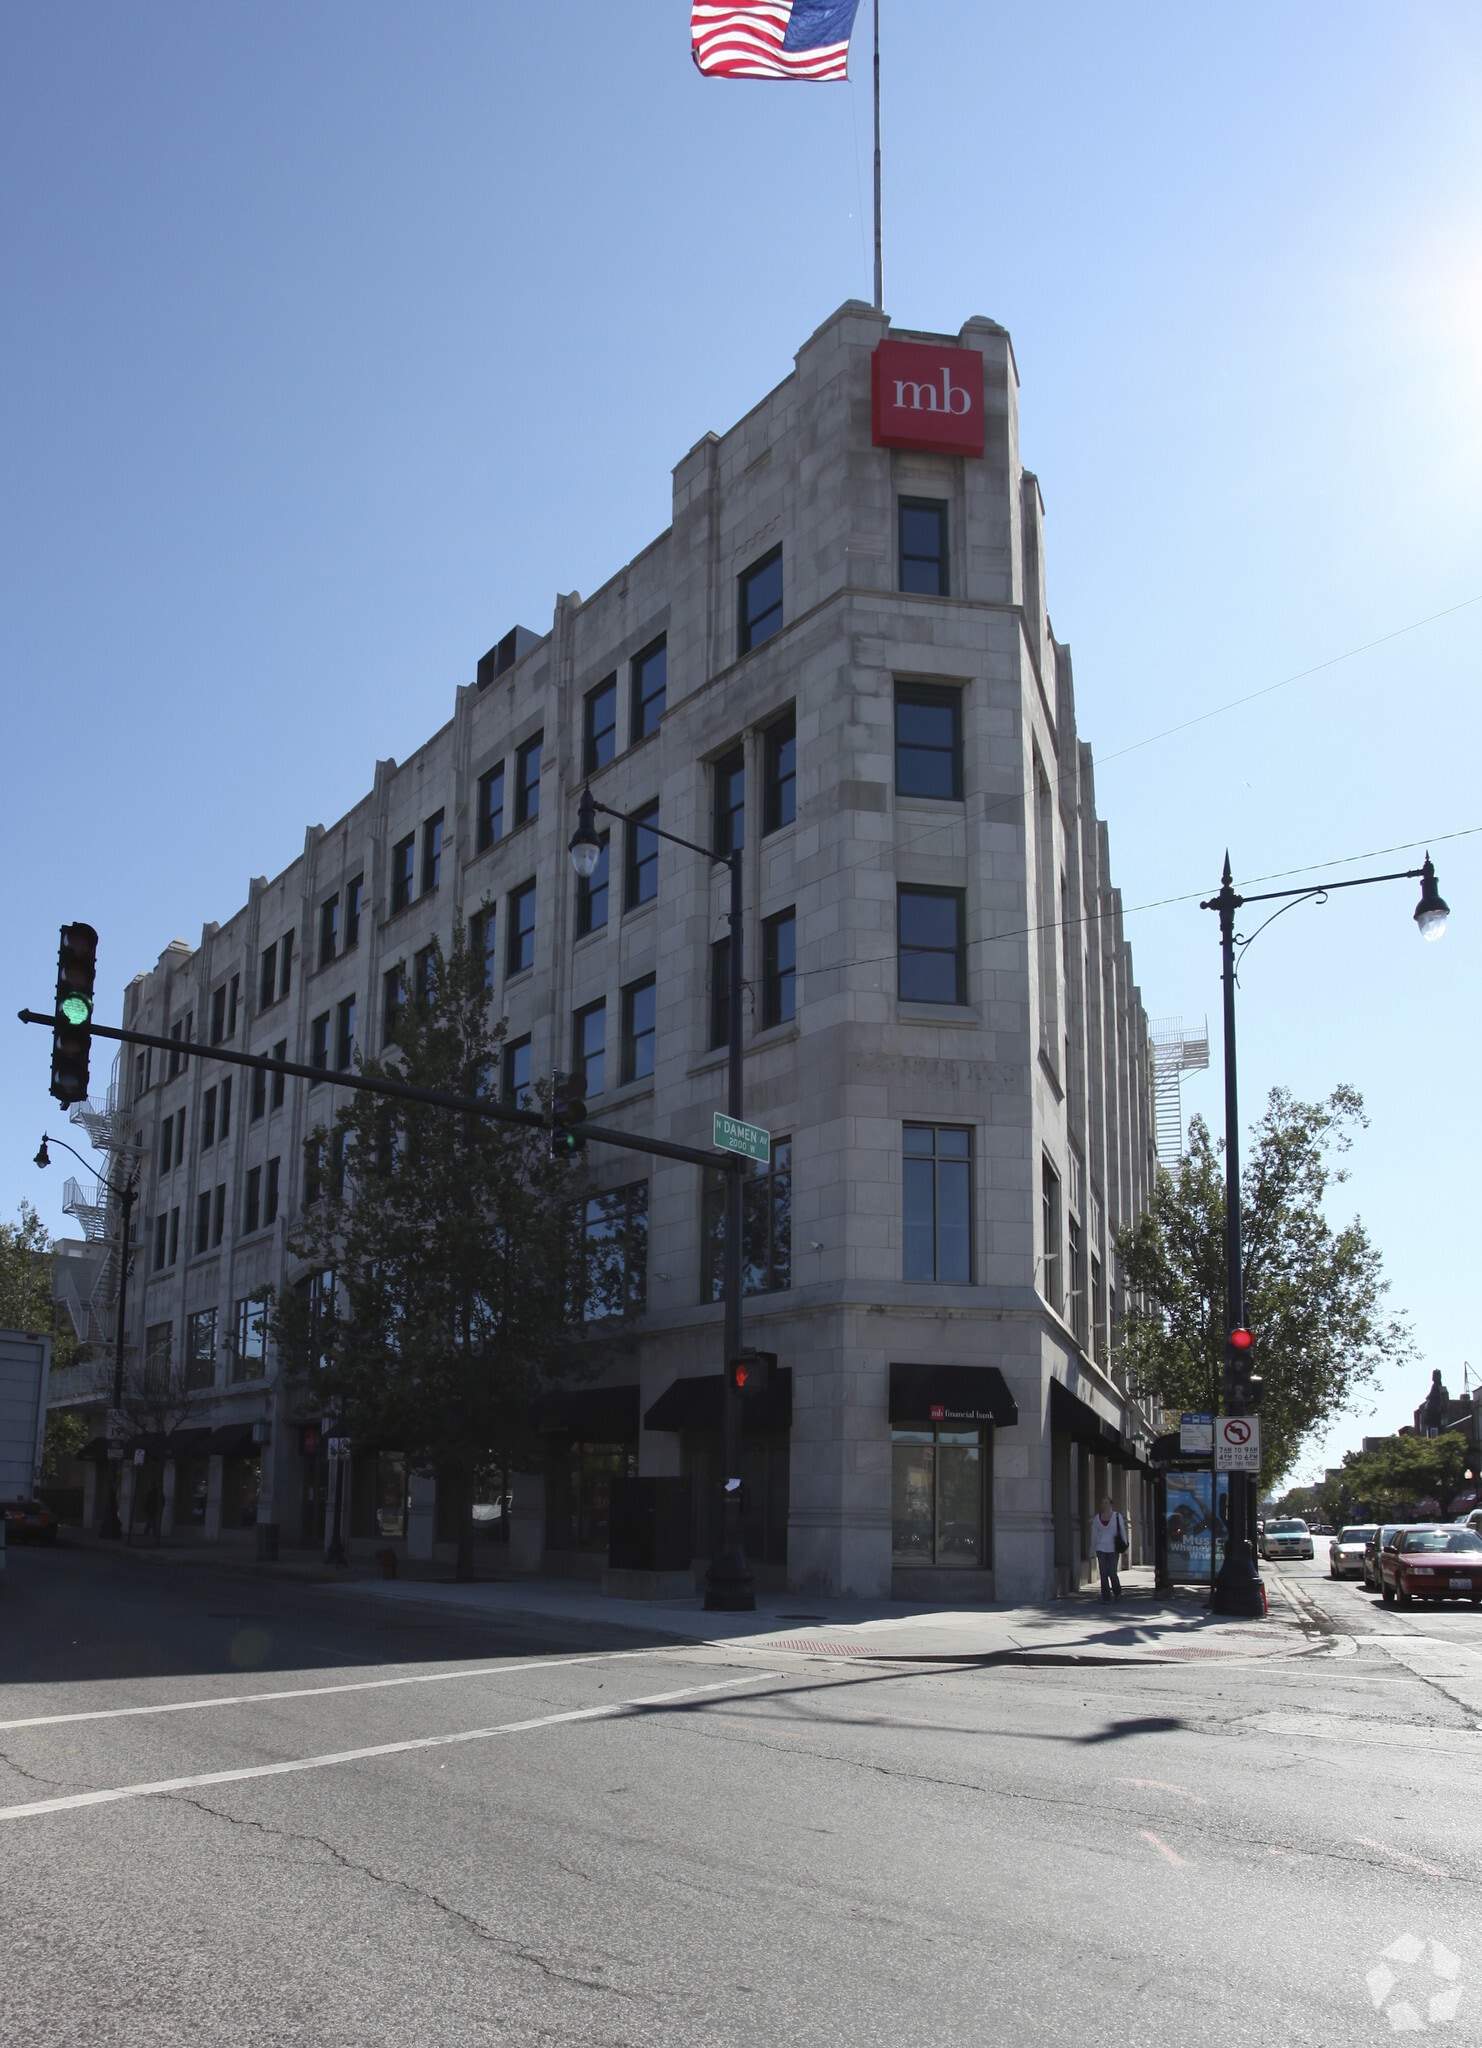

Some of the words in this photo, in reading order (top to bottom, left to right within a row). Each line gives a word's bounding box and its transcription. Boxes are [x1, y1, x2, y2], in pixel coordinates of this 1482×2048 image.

[893, 367, 971, 415] mb
[716, 1120, 721, 1129] N
[724, 1121, 757, 1143] DAMEN
[729, 1137, 747, 1151] 2000
[750, 1144, 755, 1153] W
[932, 1409, 943, 1417] mb
[945, 1409, 975, 1418] financial
[976, 1411, 994, 1419] bank
[1182, 1534, 1225, 1546] Musc.
[1170, 1543, 1223, 1552] Whenevr.
